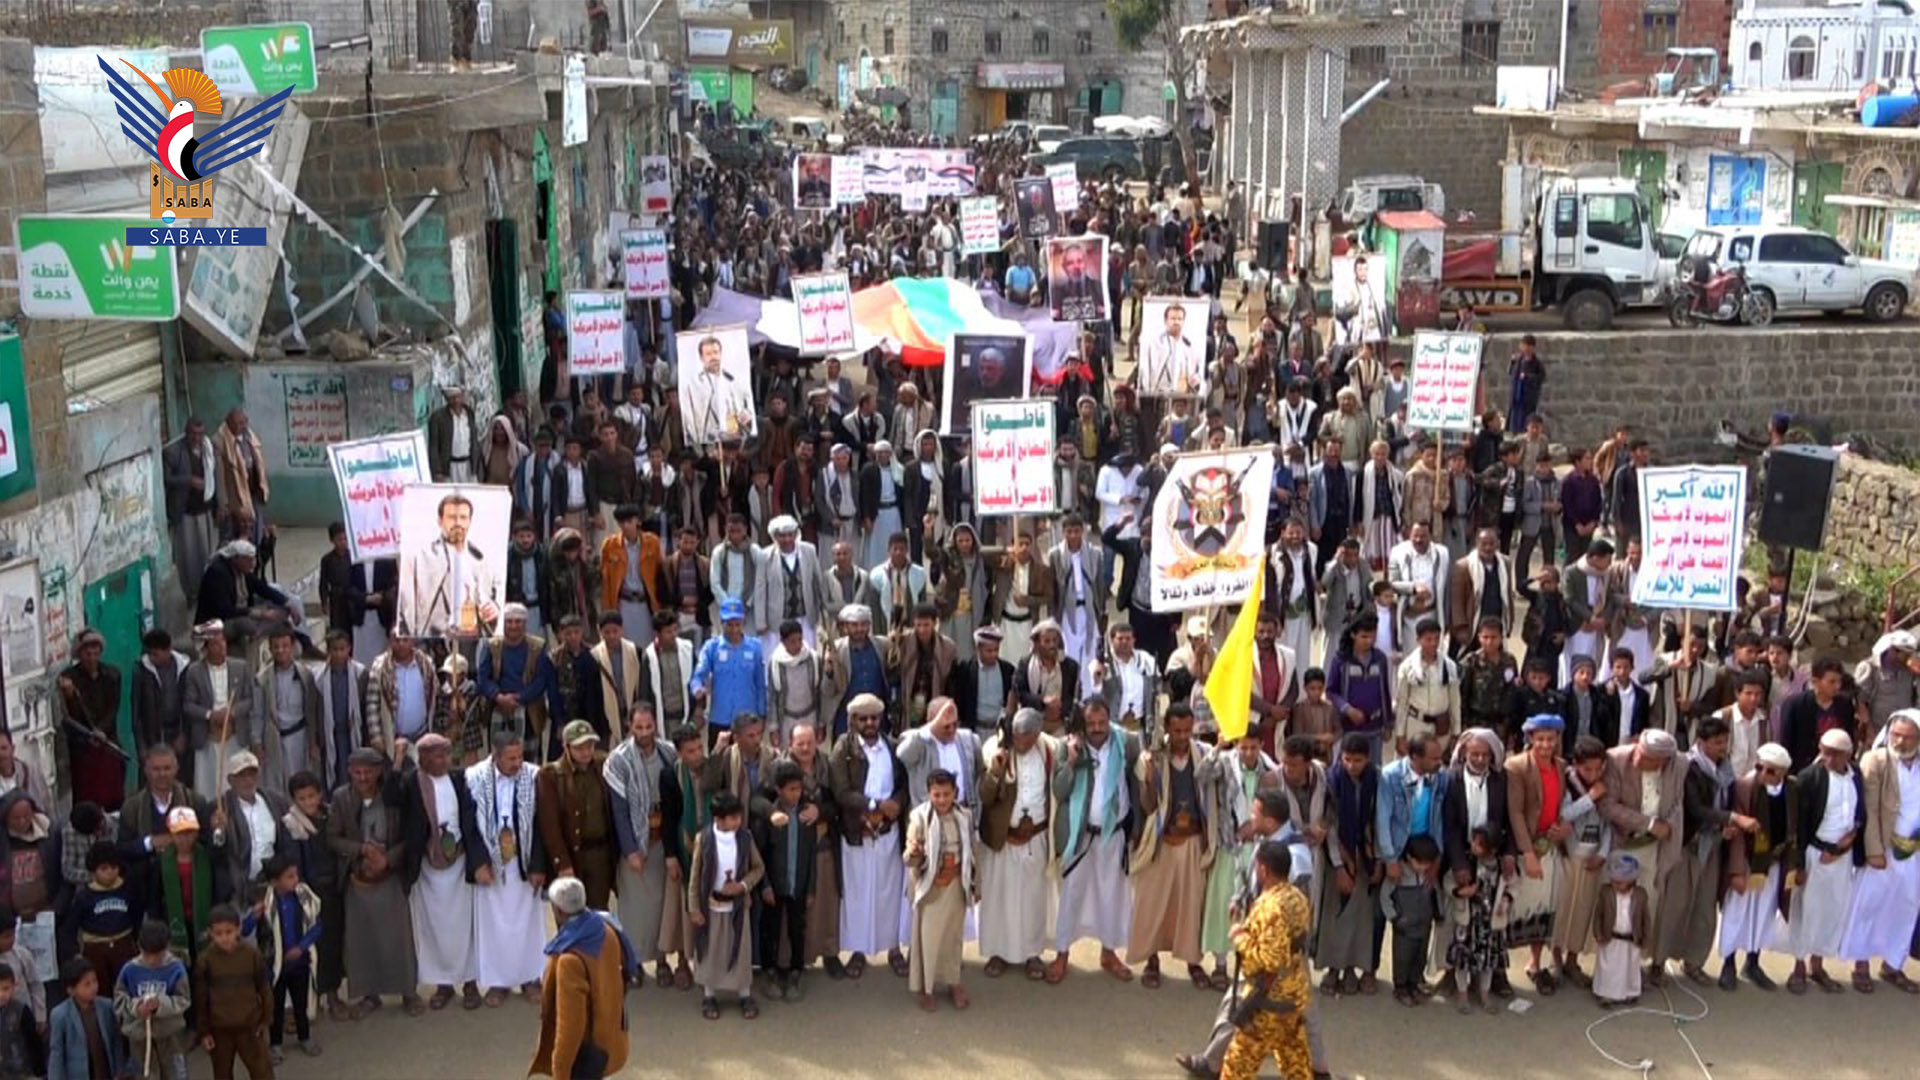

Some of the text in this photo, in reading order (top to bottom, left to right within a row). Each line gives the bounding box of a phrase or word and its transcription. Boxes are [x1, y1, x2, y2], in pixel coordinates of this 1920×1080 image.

[738, 26, 779, 49] النجم
[31, 263, 70, 279] نقطة
[102, 274, 160, 290] يمن والت
[33, 285, 73, 300] خدمة
[981, 405, 1045, 437] قاطعوا
[340, 447, 414, 478] قاطعوا
[1701, 479, 1734, 501] الله
[1689, 574, 1727, 598] النصر
